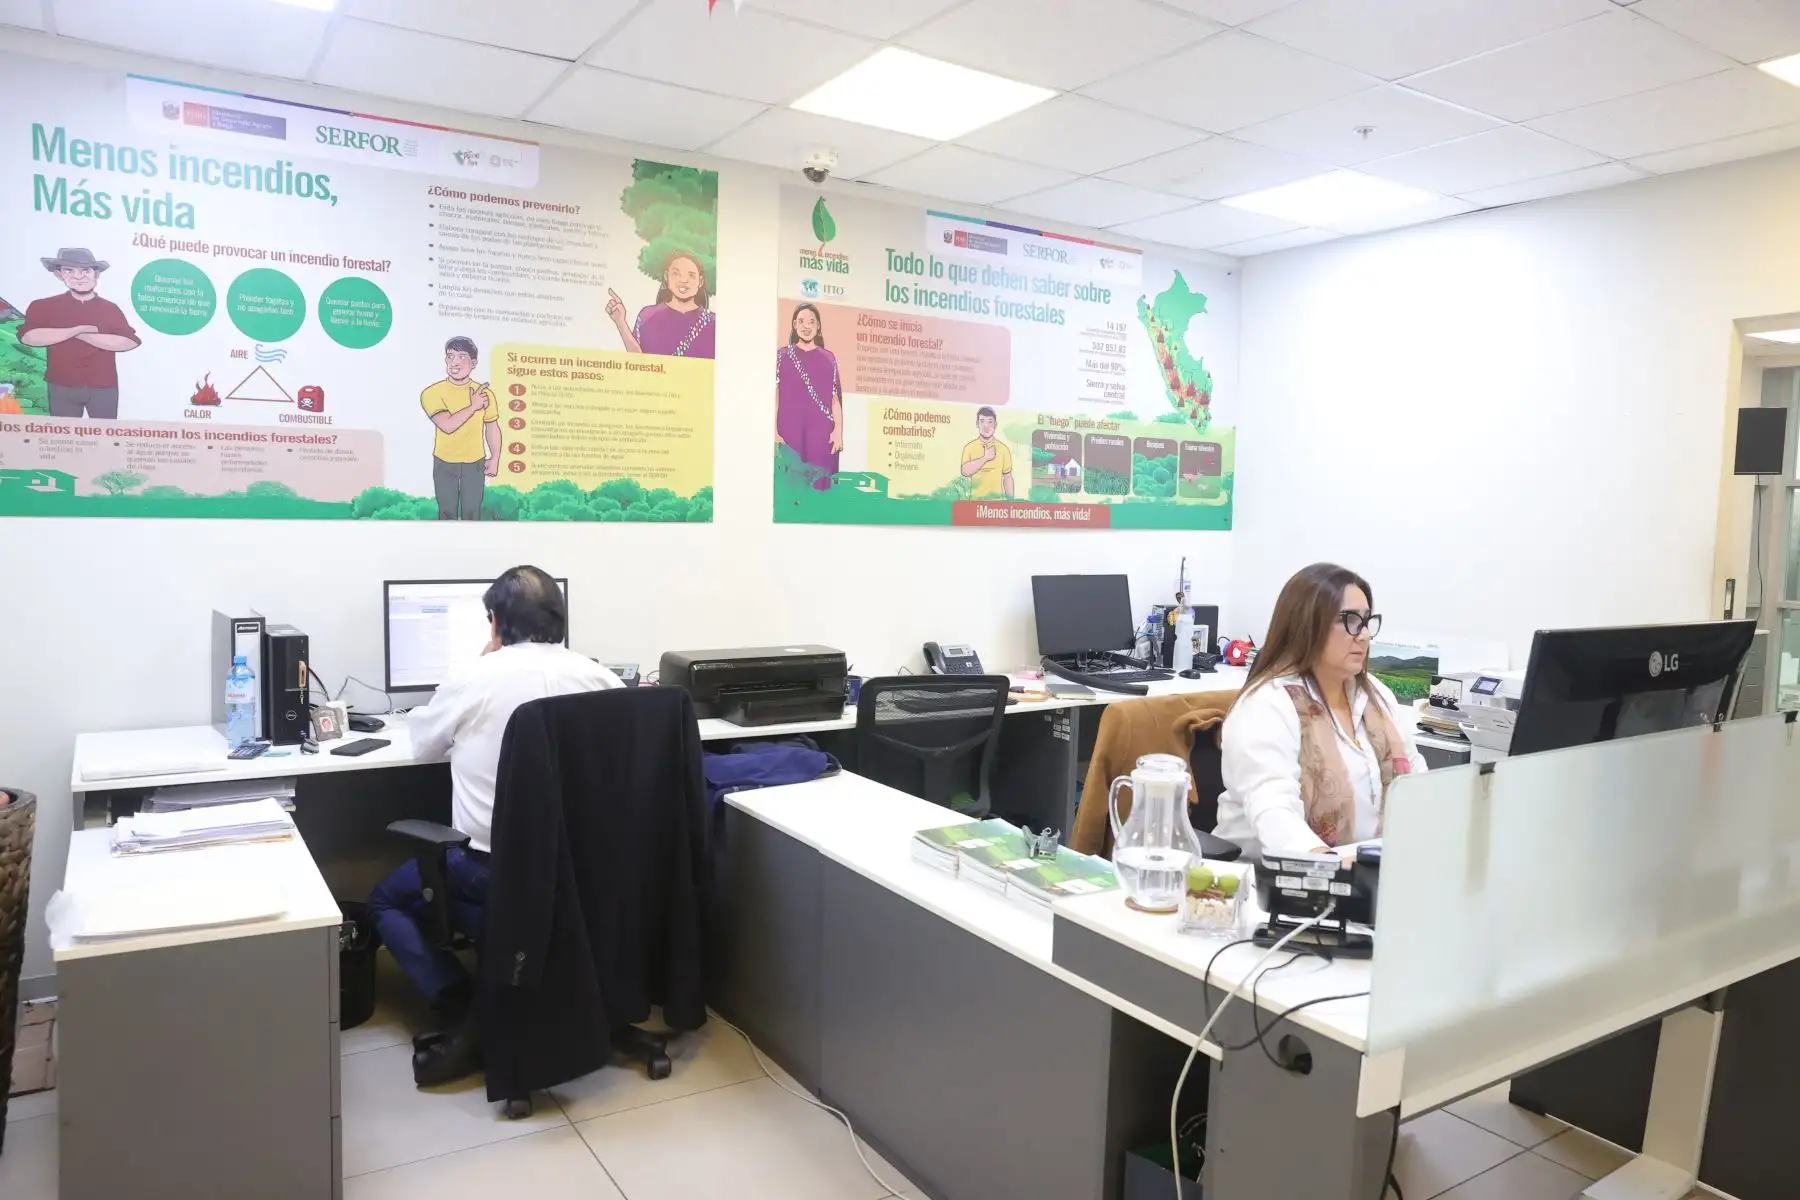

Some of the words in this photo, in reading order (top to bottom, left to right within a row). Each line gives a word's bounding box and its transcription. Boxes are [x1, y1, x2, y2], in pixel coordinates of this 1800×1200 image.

[315, 125, 403, 157] SERFOR
[32, 123, 158, 179] Menos
[169, 143, 338, 206] incendios,
[33, 174, 112, 220] Más
[121, 190, 195, 230] vida
[427, 185, 467, 200] ¿Cómo
[470, 192, 520, 208] podemos
[522, 199, 580, 215] prevenirlo?
[132, 233, 167, 250] ¿Qué
[169, 239, 210, 255] puede
[213, 243, 267, 261] provocar
[271, 251, 286, 262] un
[288, 250, 340, 268] incendio
[343, 255, 392, 273] forestal?
[1022, 243, 1070, 264] SERFOR
[799, 256, 823, 271] más
[826, 258, 850, 274] vida
[885, 247, 924, 278] Todo
[929, 253, 944, 280] lo
[948, 262, 977, 286] que
[982, 261, 1028, 289] deben
[1032, 268, 1069, 298] saber
[1073, 276, 1111, 305] sobre
[885, 278, 909, 305] los
[913, 279, 990, 316] incendios
[994, 289, 1066, 325] forestales
[857, 313, 887, 328] ¿Cómo
[888, 320, 898, 330] se
[900, 320, 923, 333] inicia
[856, 331, 867, 342] un
[869, 330, 906, 347] incendio
[908, 335, 944, 350] forestal?
[230, 349, 249, 359] AIRE
[507, 353, 518, 363] Si
[520, 355, 557, 366] ocurre
[560, 358, 574, 367] un
[576, 355, 622, 370] incendio
[625, 361, 666, 375] forestal,
[507, 365, 536, 377] sigue
[539, 367, 568, 378] estos
[571, 370, 605, 382] pasos:
[513, 384, 521, 396] 1
[184, 409, 212, 419] CALOR
[512, 400, 521, 411] 2
[278, 413, 333, 425] COMBUSTIBLE
[513, 418, 521, 429] 3
[883, 407, 912, 421] ¿Cómo
[914, 411, 951, 424] podemos
[1037, 414, 1044, 425] El
[1074, 417, 1095, 430] puede
[1096, 419, 1120, 431] afectar
[25, 421, 71, 436] daños
[75, 424, 101, 438] que
[106, 425, 177, 440] ocasionan
[181, 428, 200, 440] los
[204, 429, 267, 443] incendios
[270, 431, 338, 446] forestales?
[883, 425, 936, 438] combatirlos?
[513, 443, 522, 454] 4
[513, 462, 521, 473] 5
[976, 505, 1009, 521] ¡Menos
[1010, 505, 1052, 521] incendios,
[1054, 507, 1070, 521] más
[1072, 507, 1091, 522] vida!
[1664, 653, 1679, 672] LG
